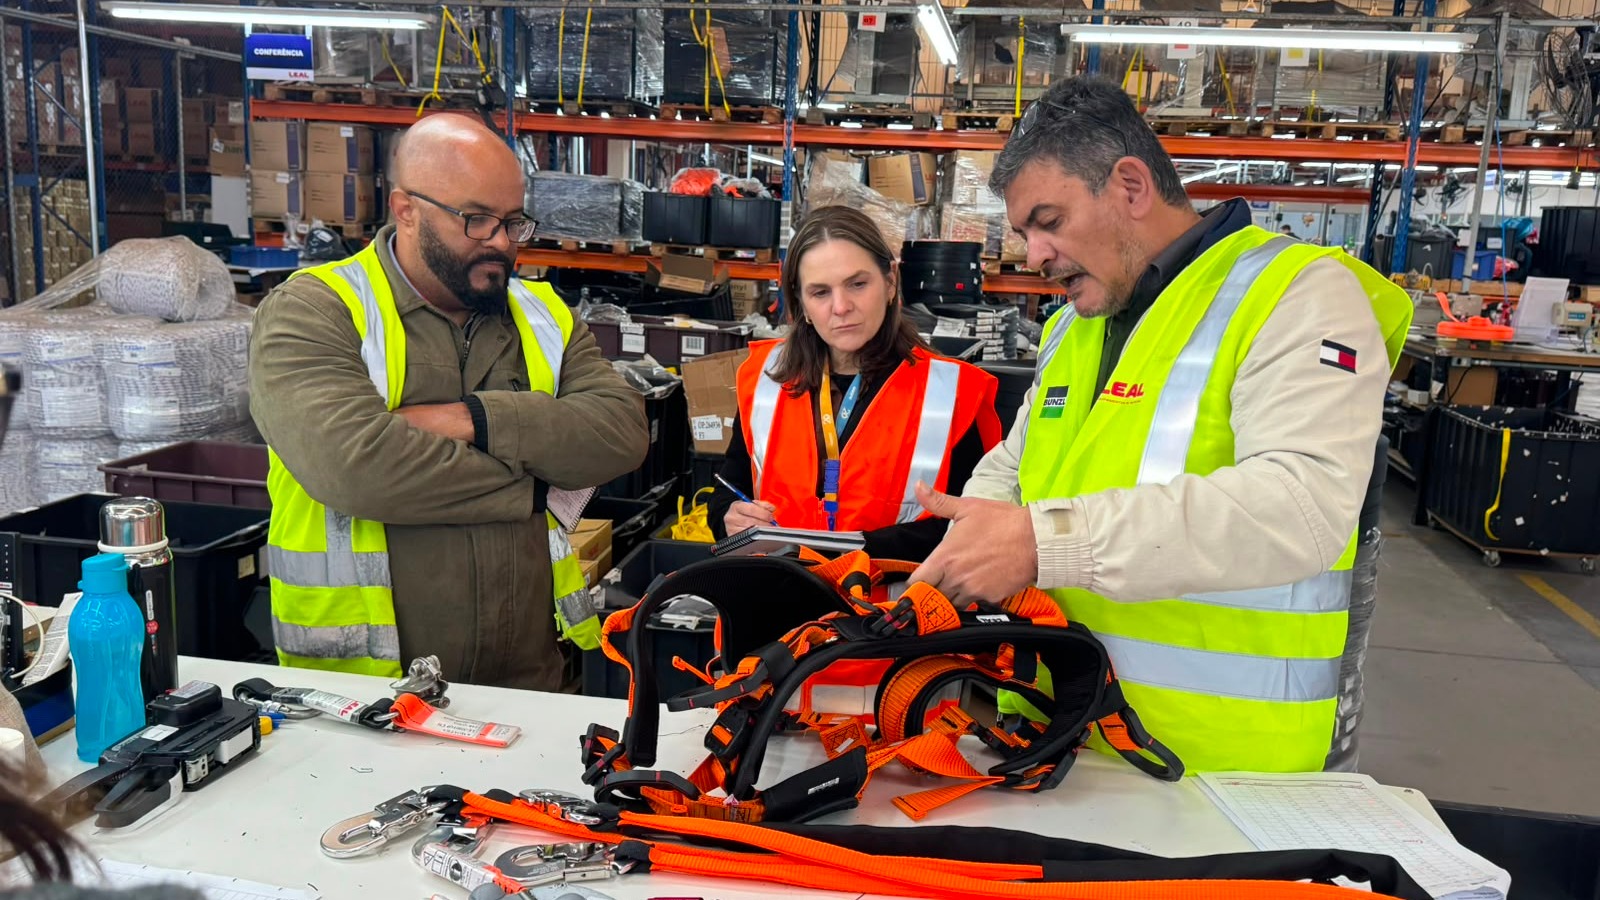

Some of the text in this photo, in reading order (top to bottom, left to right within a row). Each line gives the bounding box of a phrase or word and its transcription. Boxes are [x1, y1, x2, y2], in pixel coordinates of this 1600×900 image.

[253, 47, 304, 57] CONFERÊNCIA
[288, 71, 309, 79] LEAL
[1044, 398, 1066, 406] BUNZL
